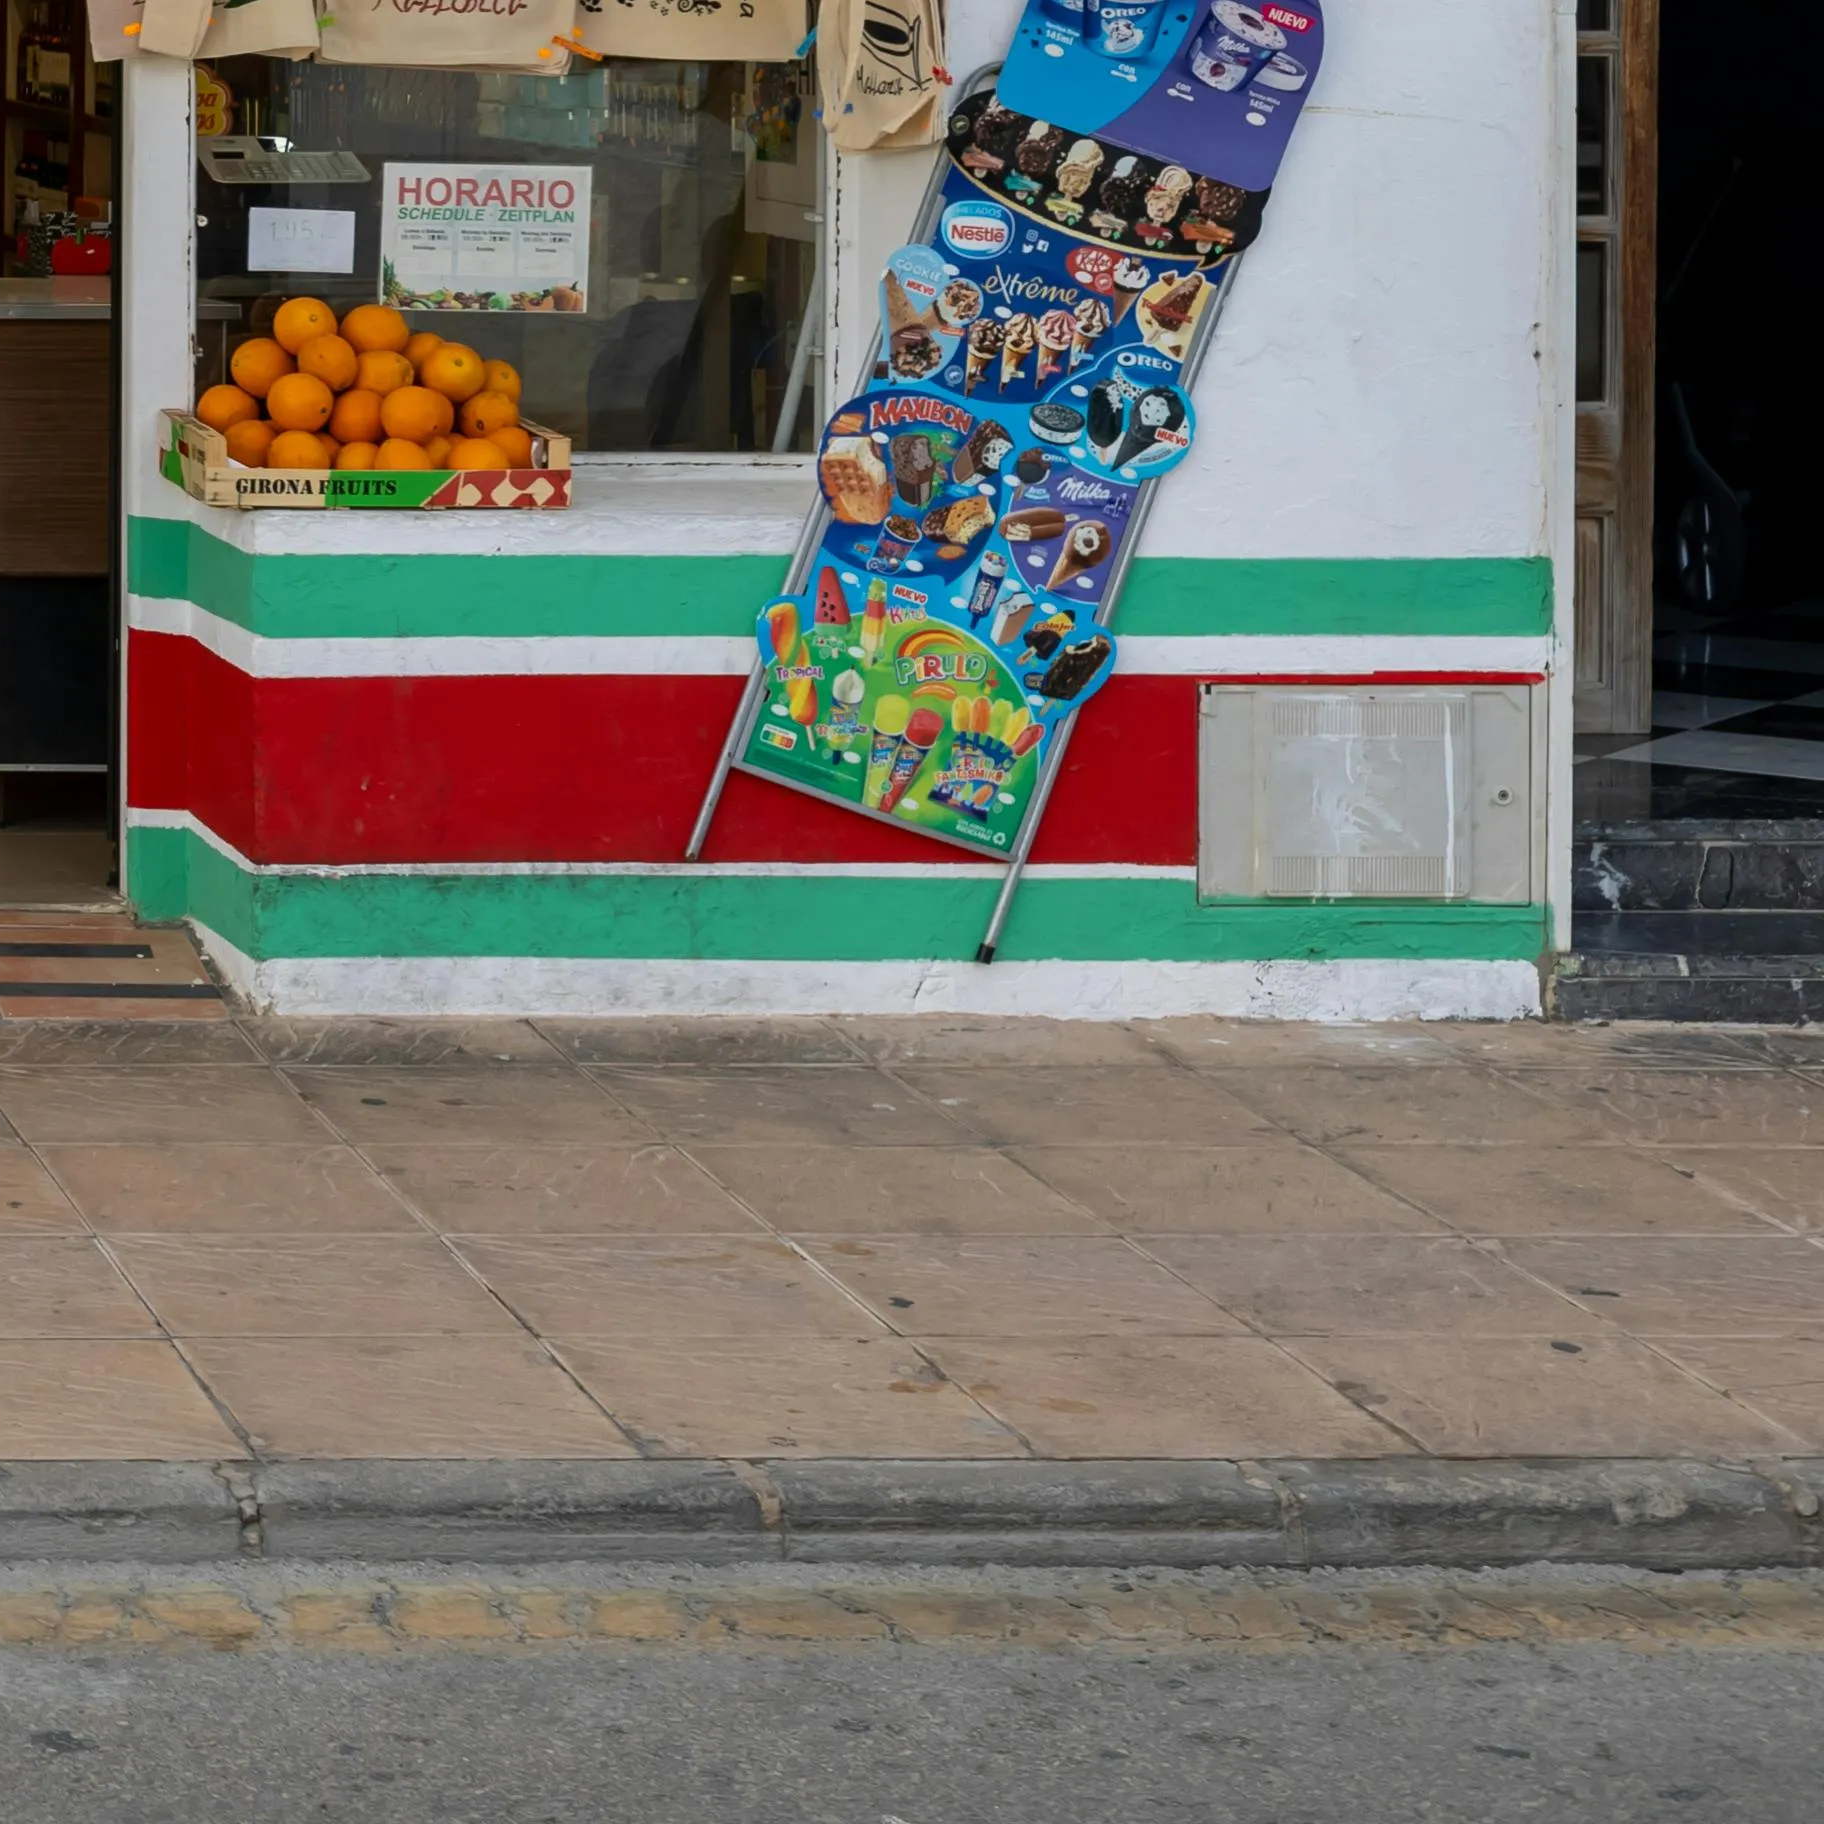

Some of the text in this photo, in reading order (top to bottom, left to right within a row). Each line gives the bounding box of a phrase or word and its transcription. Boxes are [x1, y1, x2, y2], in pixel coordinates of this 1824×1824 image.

[1101, 6, 1147, 19] OREO
[1268, 8, 1309, 30] NUEVO
[1216, 36, 1251, 54] Milka
[398, 177, 575, 209] HORARIO
[397, 207, 574, 223] SCHEDULE ZEITPLAN
[905, 280, 936, 296] NUEVO
[1117, 351, 1173, 372] OREO
[870, 396, 973, 435] MAXIBON
[1156, 428, 1189, 448] NUEVO
[235, 478, 397, 496] GIRONA FRUITS
[1057, 476, 1112, 501] Milka
[893, 585, 929, 604] NUEVO
